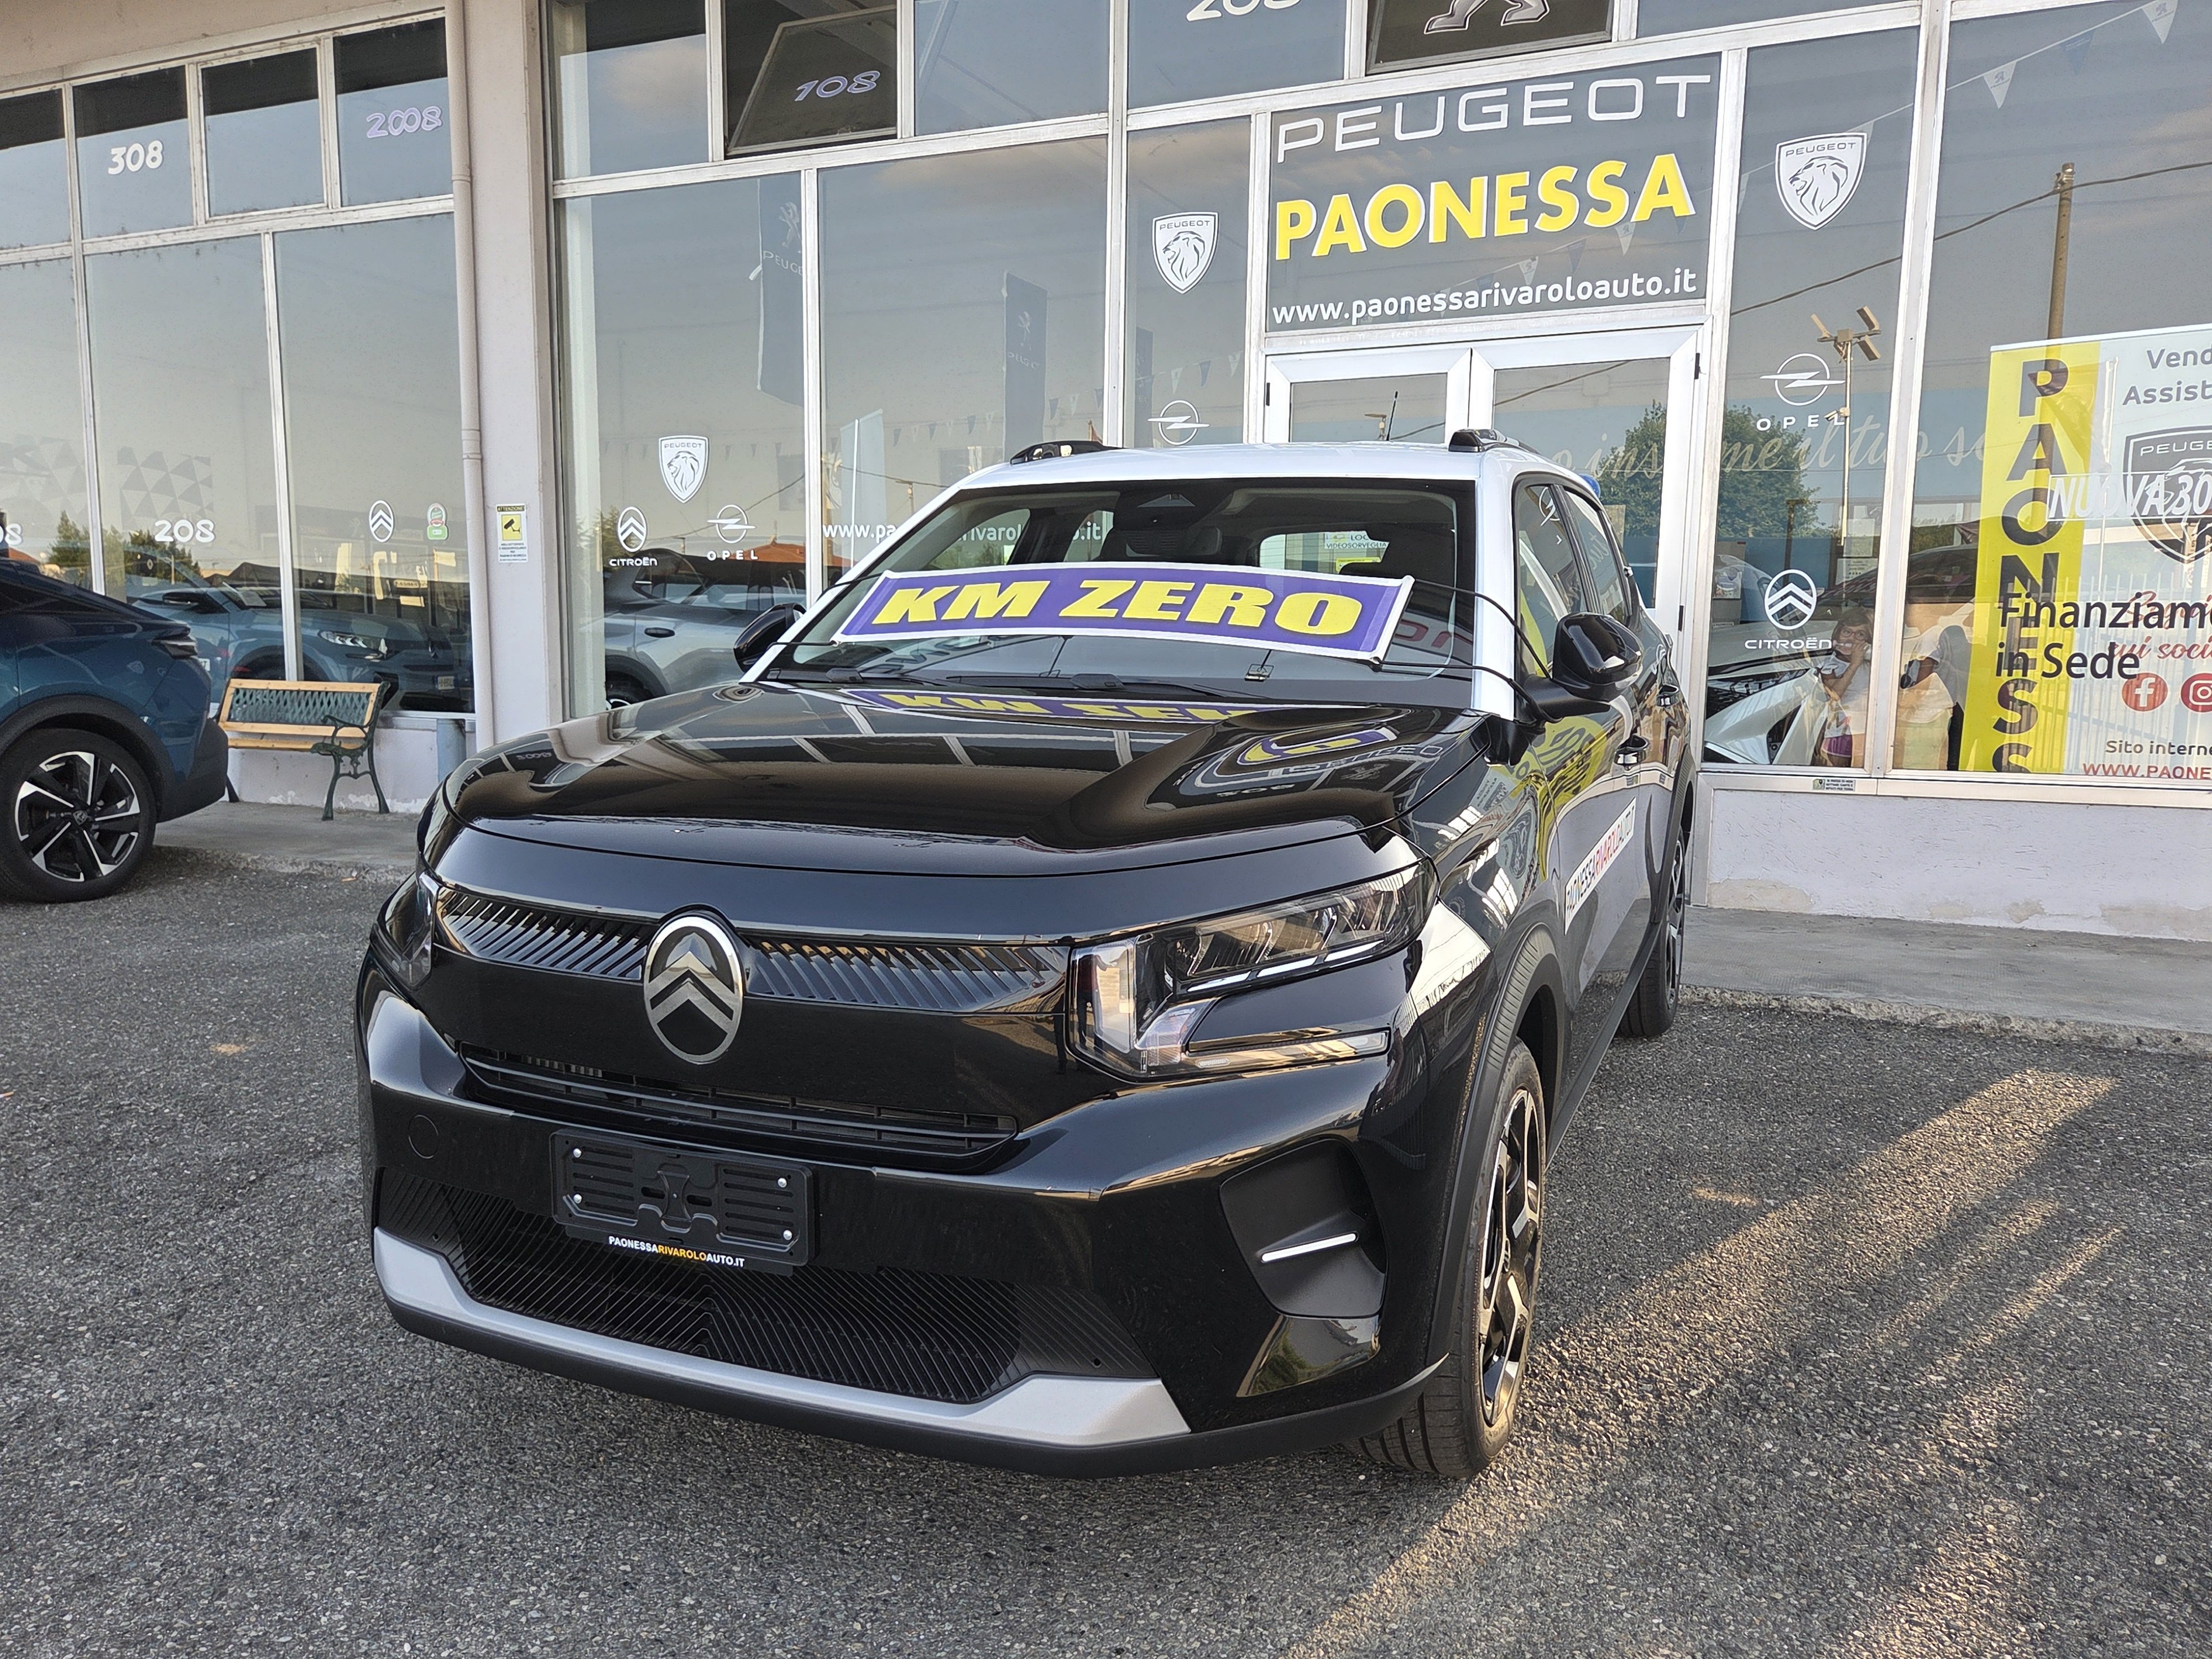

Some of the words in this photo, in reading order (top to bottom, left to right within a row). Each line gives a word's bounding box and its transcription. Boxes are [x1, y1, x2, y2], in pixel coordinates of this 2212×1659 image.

[794, 70, 880, 101] 108
[366, 106, 442, 138] 2008
[1277, 75, 1711, 163] PEUGEOT
[108, 140, 163, 175] 308
[1786, 142, 1856, 157] PEUGEOT
[1276, 153, 1695, 260] PAONESSA
[1160, 220, 1211, 230] PEUGEOT
[1272, 268, 1697, 325] www.paonessarivaroloauto.it
[1756, 414, 1845, 432] OPEL
[154, 519, 215, 543] 208
[707, 550, 758, 561] OPEL
[872, 581, 1048, 624] KM
[1059, 580, 1363, 635] ZERO
[1998, 592, 2212, 628] Finanziam
[1996, 641, 2029, 677] in
[2041, 641, 2140, 679] Sede
[2105, 740, 2143, 754] Sito
[2149, 740, 2212, 756] intern
[608, 1235, 745, 1267] PAONESSARIVAROLOAUTO.IT
